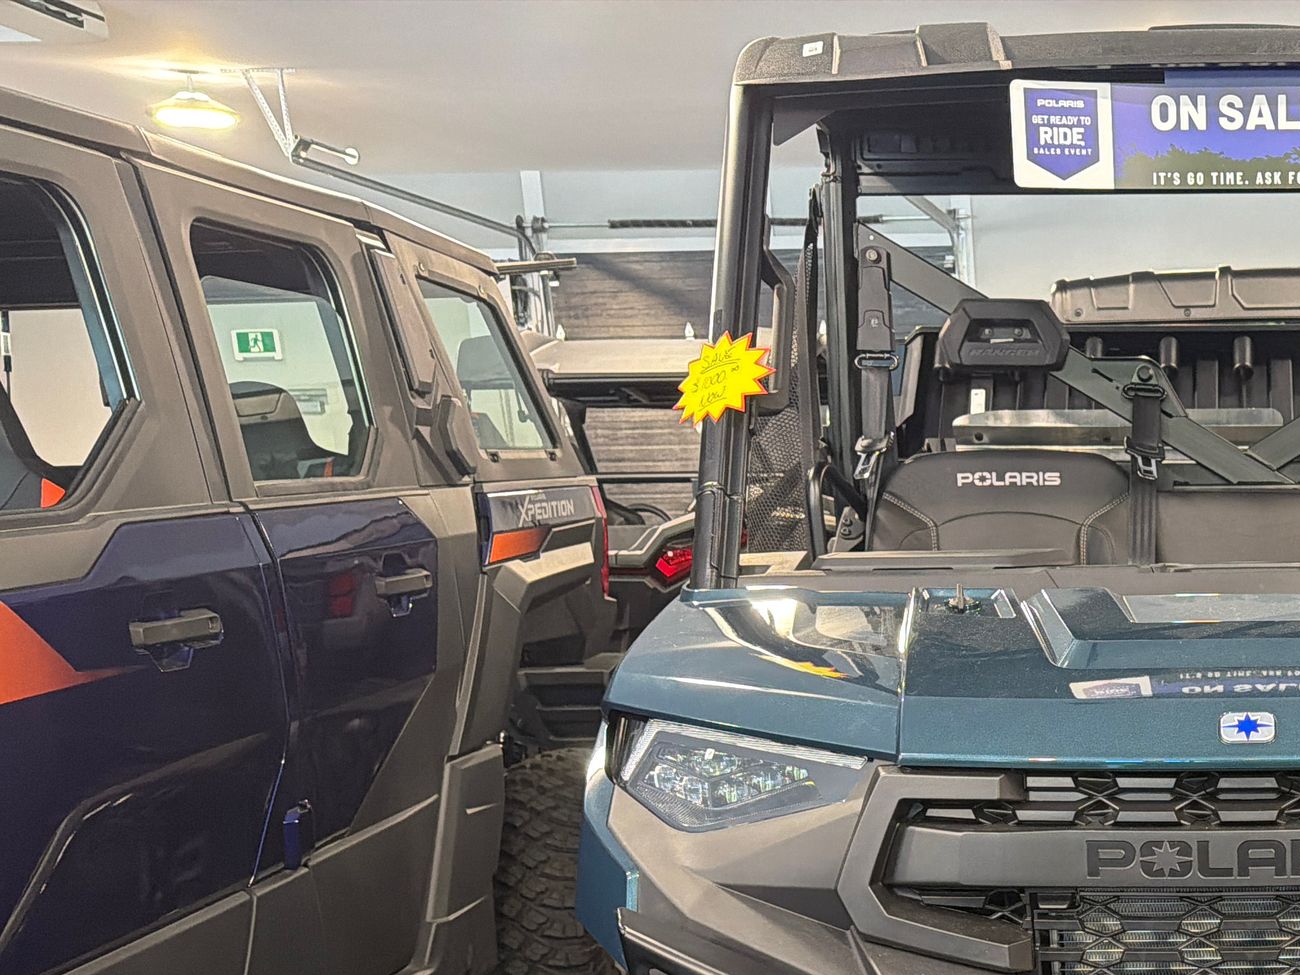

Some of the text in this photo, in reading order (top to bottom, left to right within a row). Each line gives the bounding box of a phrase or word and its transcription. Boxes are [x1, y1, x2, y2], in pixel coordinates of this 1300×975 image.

[1037, 98, 1084, 108] POLARIS
[1151, 94, 1206, 130] ON
[1032, 115, 1092, 125] GET READY TO
[1039, 126, 1085, 146] RIDE
[1152, 172, 1181, 186] IT'S
[1187, 172, 1204, 185] GO
[1211, 172, 1249, 185] TIME.
[1256, 172, 1282, 185] ASK
[956, 472, 1061, 487] POLARIS
[518, 496, 575, 527] XPEDITION
